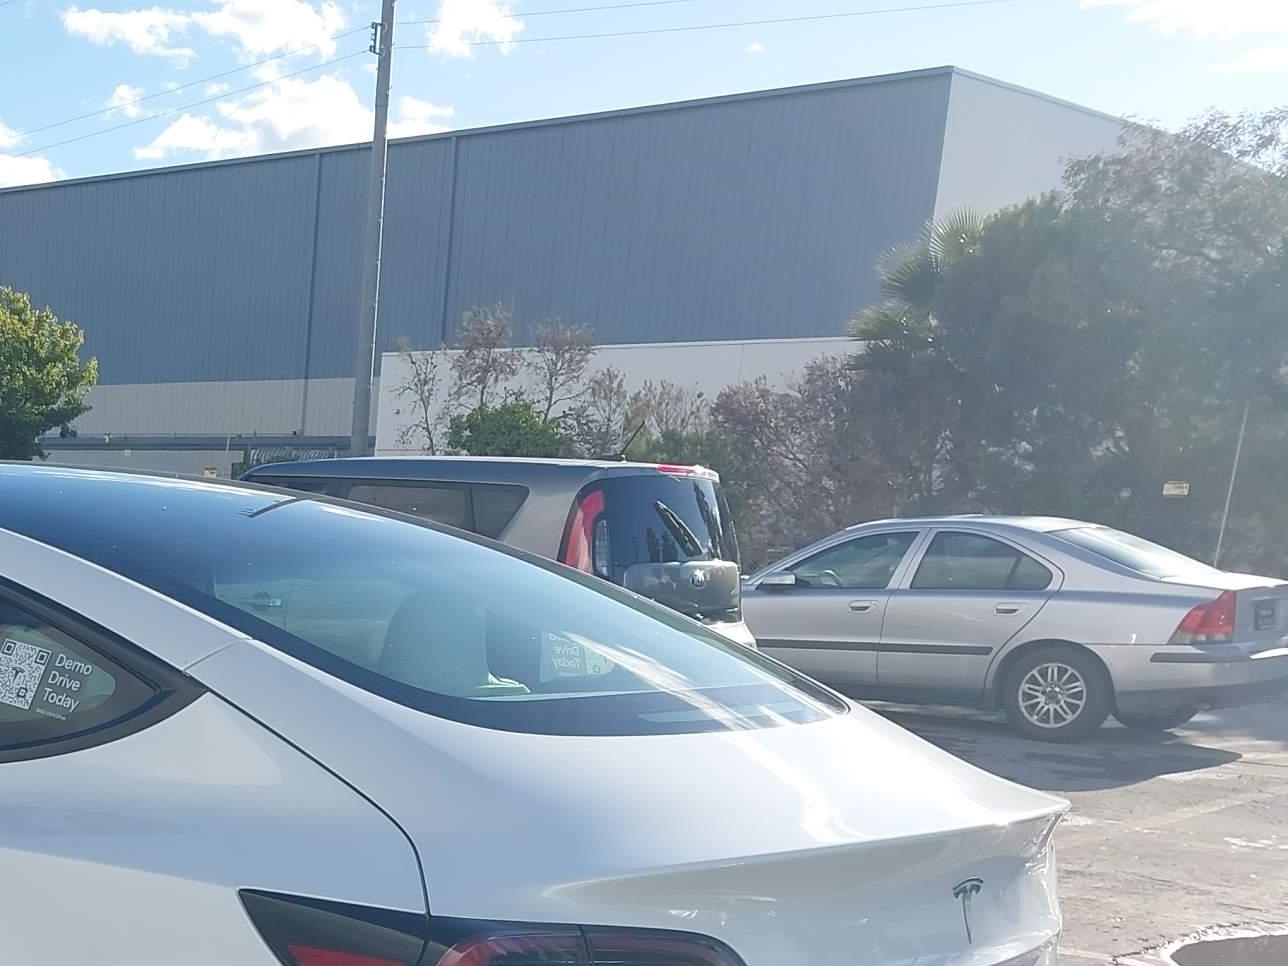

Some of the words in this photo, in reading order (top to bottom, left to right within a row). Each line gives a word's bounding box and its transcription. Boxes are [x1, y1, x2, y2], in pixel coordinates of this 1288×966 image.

[55, 654, 92, 675] Demo
[48, 671, 81, 692] Drive
[43, 688, 80, 713] Today
